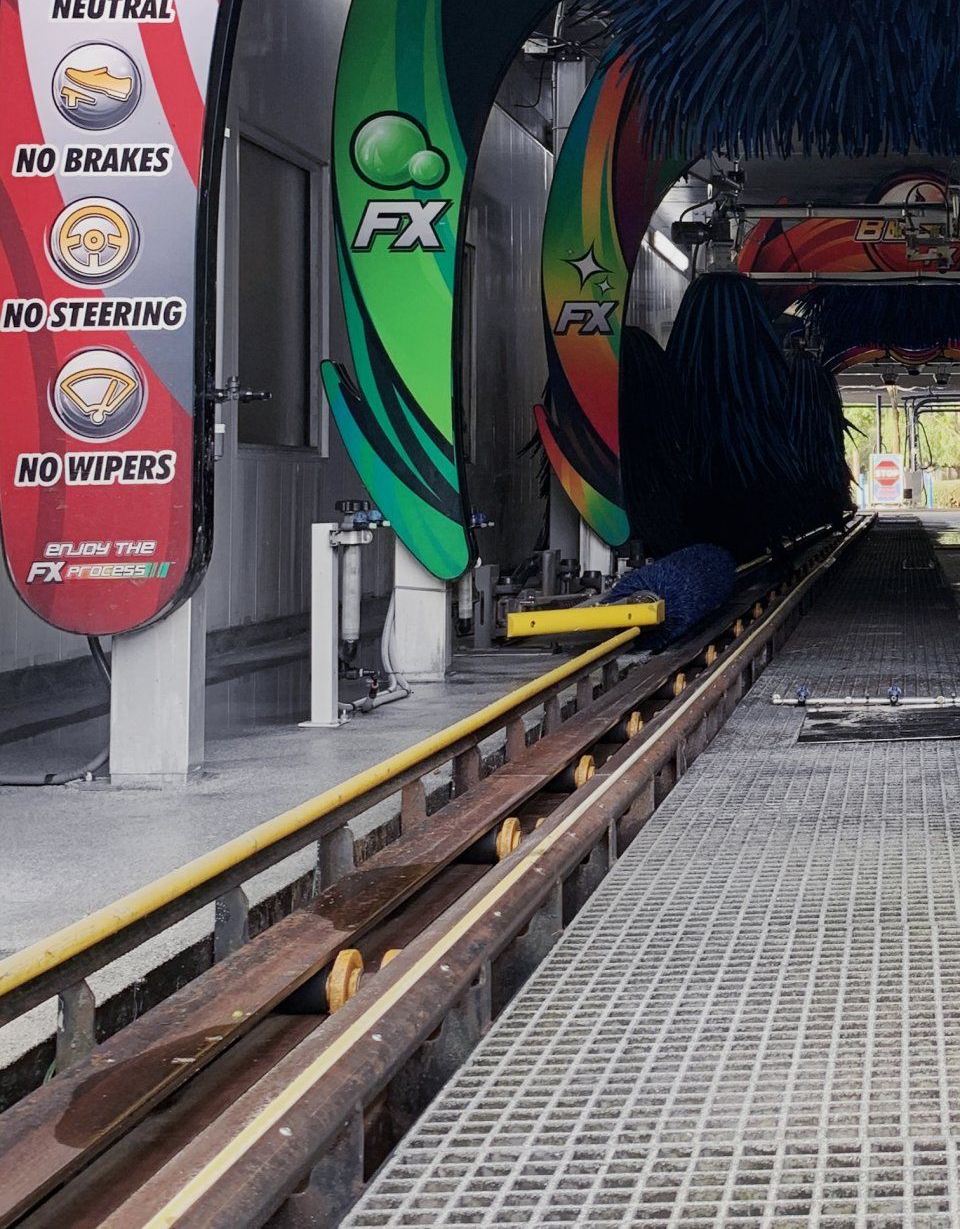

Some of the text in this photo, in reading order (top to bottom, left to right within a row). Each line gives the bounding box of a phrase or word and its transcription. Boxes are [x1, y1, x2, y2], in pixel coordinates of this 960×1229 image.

[16, 147, 170, 173] NO BRAKES
[350, 199, 454, 253] FX
[3, 300, 184, 328] NO STEERING
[554, 300, 619, 336] FX
[18, 453, 174, 484] NO WIPERS
[26, 561, 66, 584] FX
